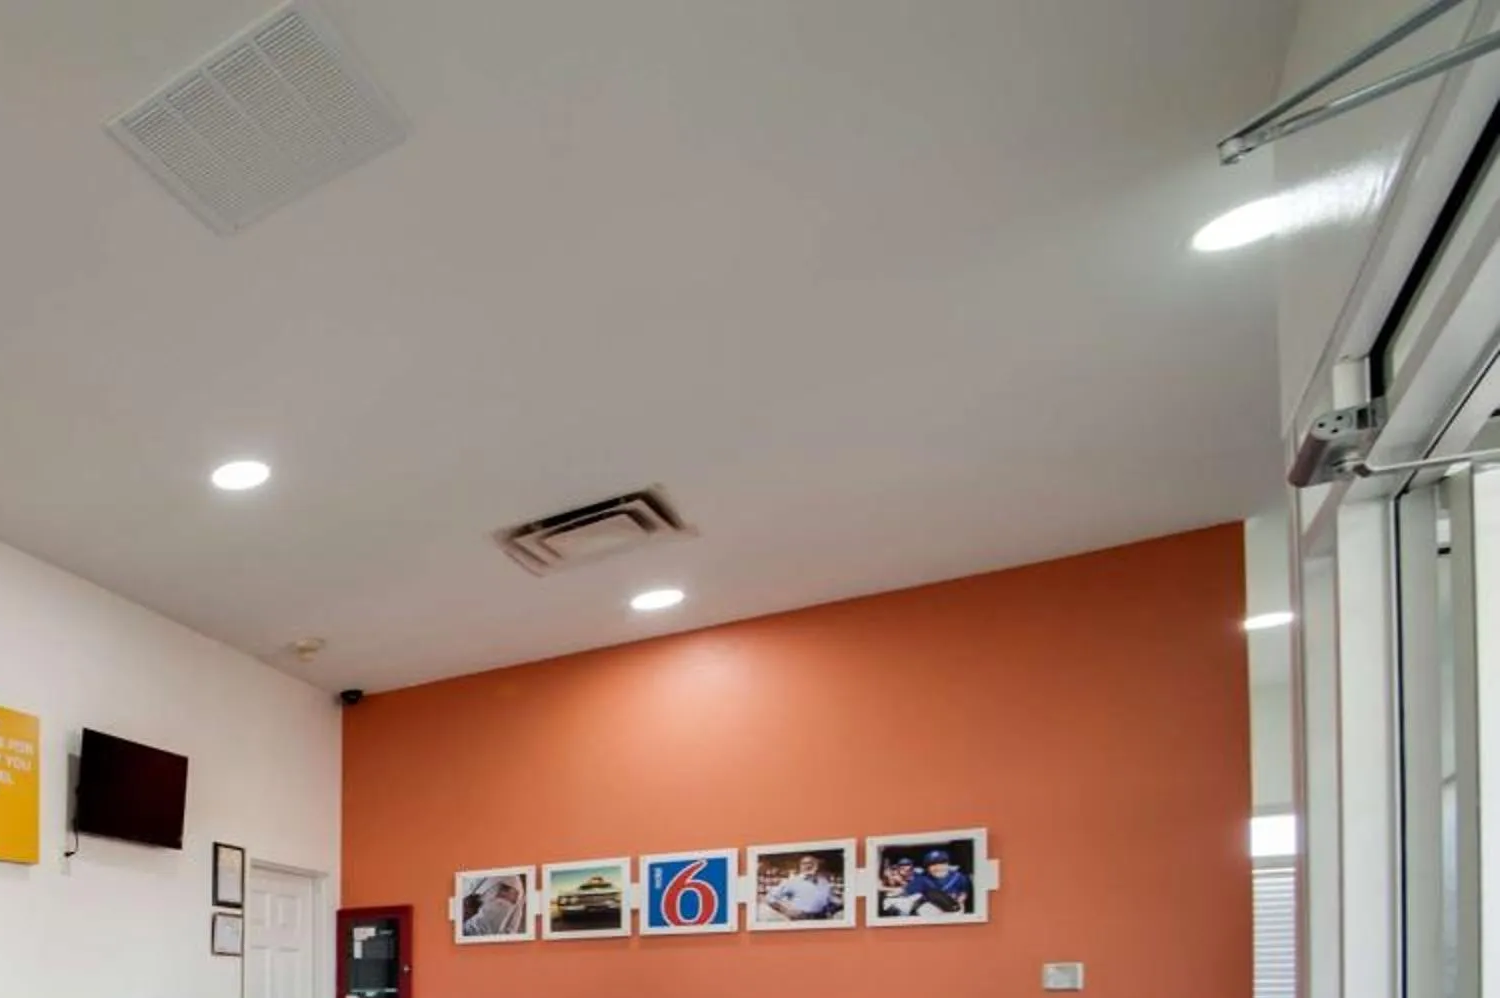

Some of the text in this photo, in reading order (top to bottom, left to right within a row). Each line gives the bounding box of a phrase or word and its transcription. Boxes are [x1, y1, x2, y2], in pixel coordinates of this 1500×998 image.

[8, 738, 34, 755] FOR
[5, 755, 32, 771] YOU
[661, 859, 718, 927] 6
